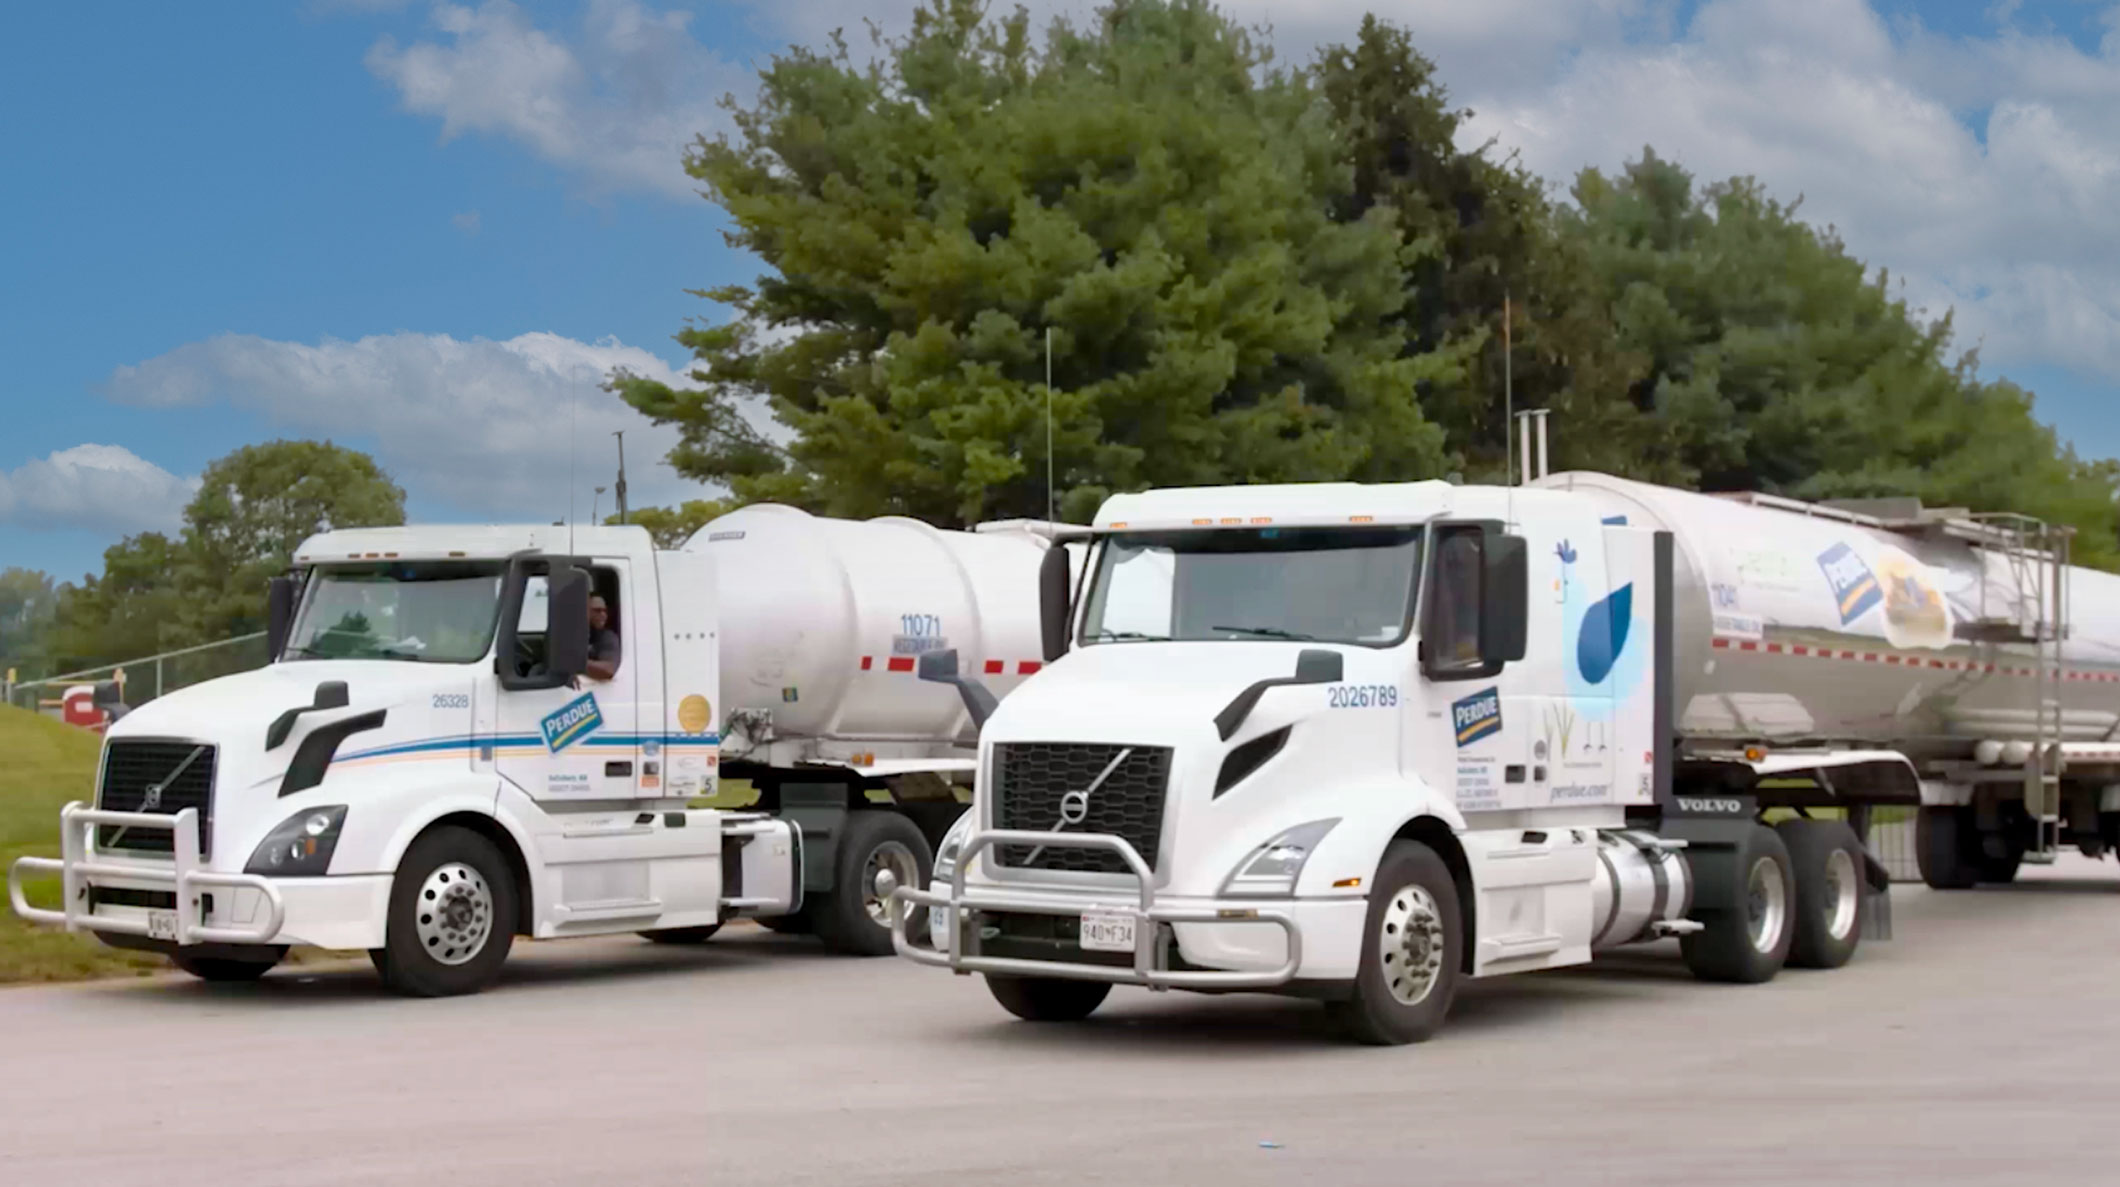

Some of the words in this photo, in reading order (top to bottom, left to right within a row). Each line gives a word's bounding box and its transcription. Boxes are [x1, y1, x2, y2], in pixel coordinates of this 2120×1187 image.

[901, 613, 939, 636] 11071
[432, 693, 469, 708] 26328
[1328, 684, 1398, 708] 2026789
[545, 698, 595, 738] PERDUE
[1455, 696, 1497, 726] PERDUE
[704, 777, 713, 791] 5
[1550, 781, 1608, 802] perdue.com
[1677, 797, 1742, 813] VOLVO
